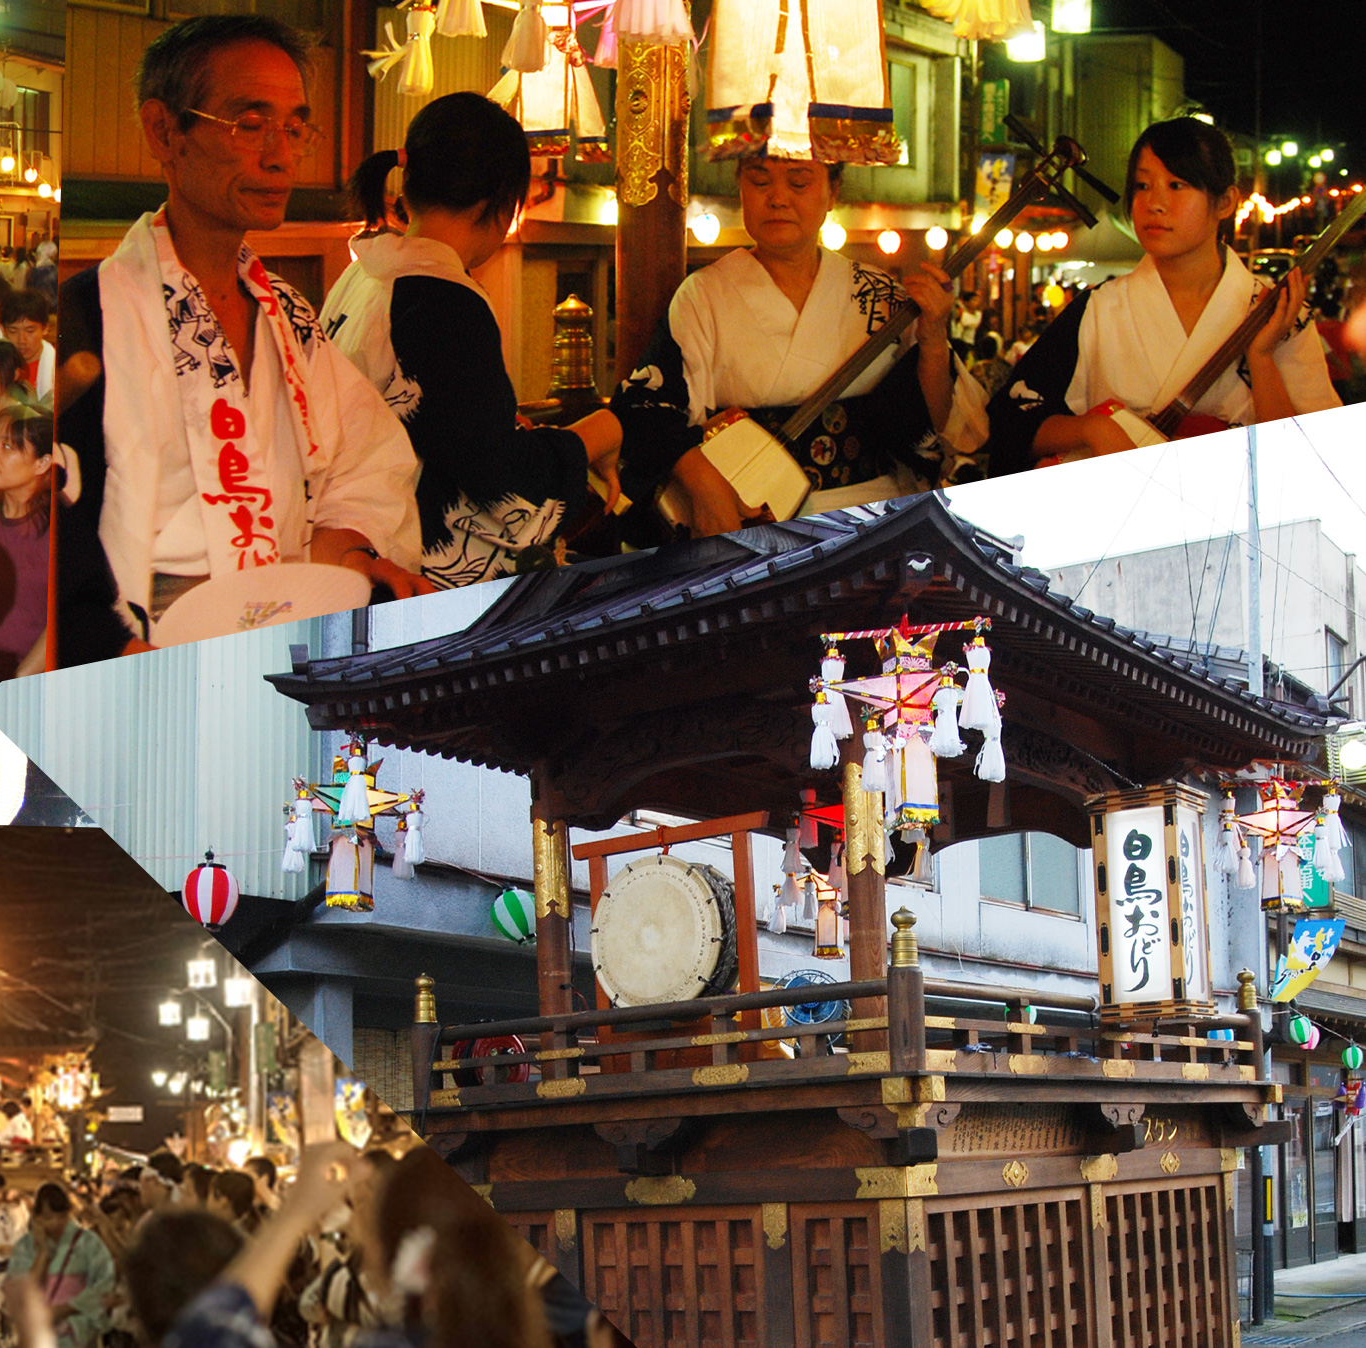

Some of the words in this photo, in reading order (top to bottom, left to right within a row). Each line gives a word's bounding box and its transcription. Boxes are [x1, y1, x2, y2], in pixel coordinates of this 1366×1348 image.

[1116, 828, 1163, 992] 白鳥おどり
[1180, 828, 1197, 986] 白鳥おどり
